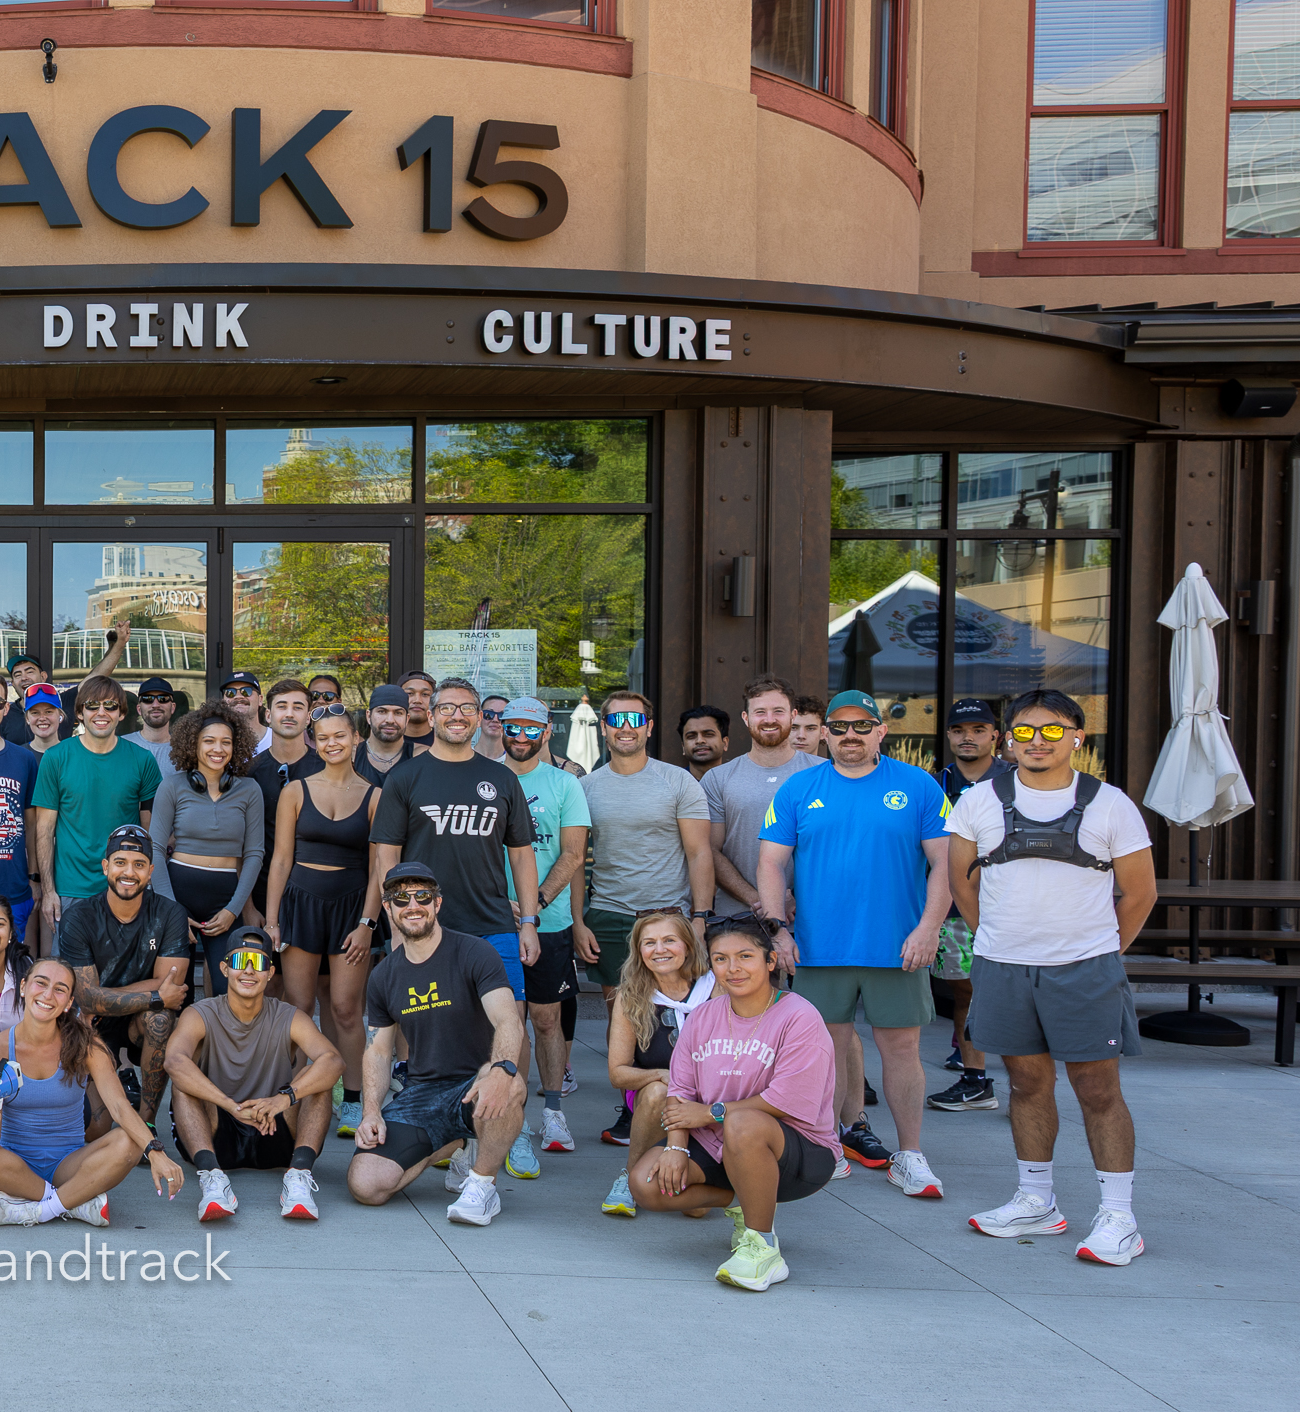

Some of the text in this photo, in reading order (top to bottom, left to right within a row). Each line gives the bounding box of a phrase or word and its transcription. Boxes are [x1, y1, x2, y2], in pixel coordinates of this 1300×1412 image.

[396, 115, 568, 242] 15
[43, 303, 250, 348] DRINK
[483, 310, 732, 360] CULTURE
[425, 644, 535, 652] PATIO BAR FAVORITES
[419, 804, 499, 837] VOLO
[535, 833, 554, 844] RT
[401, 1000, 452, 1015] MARATHON SPORTS
